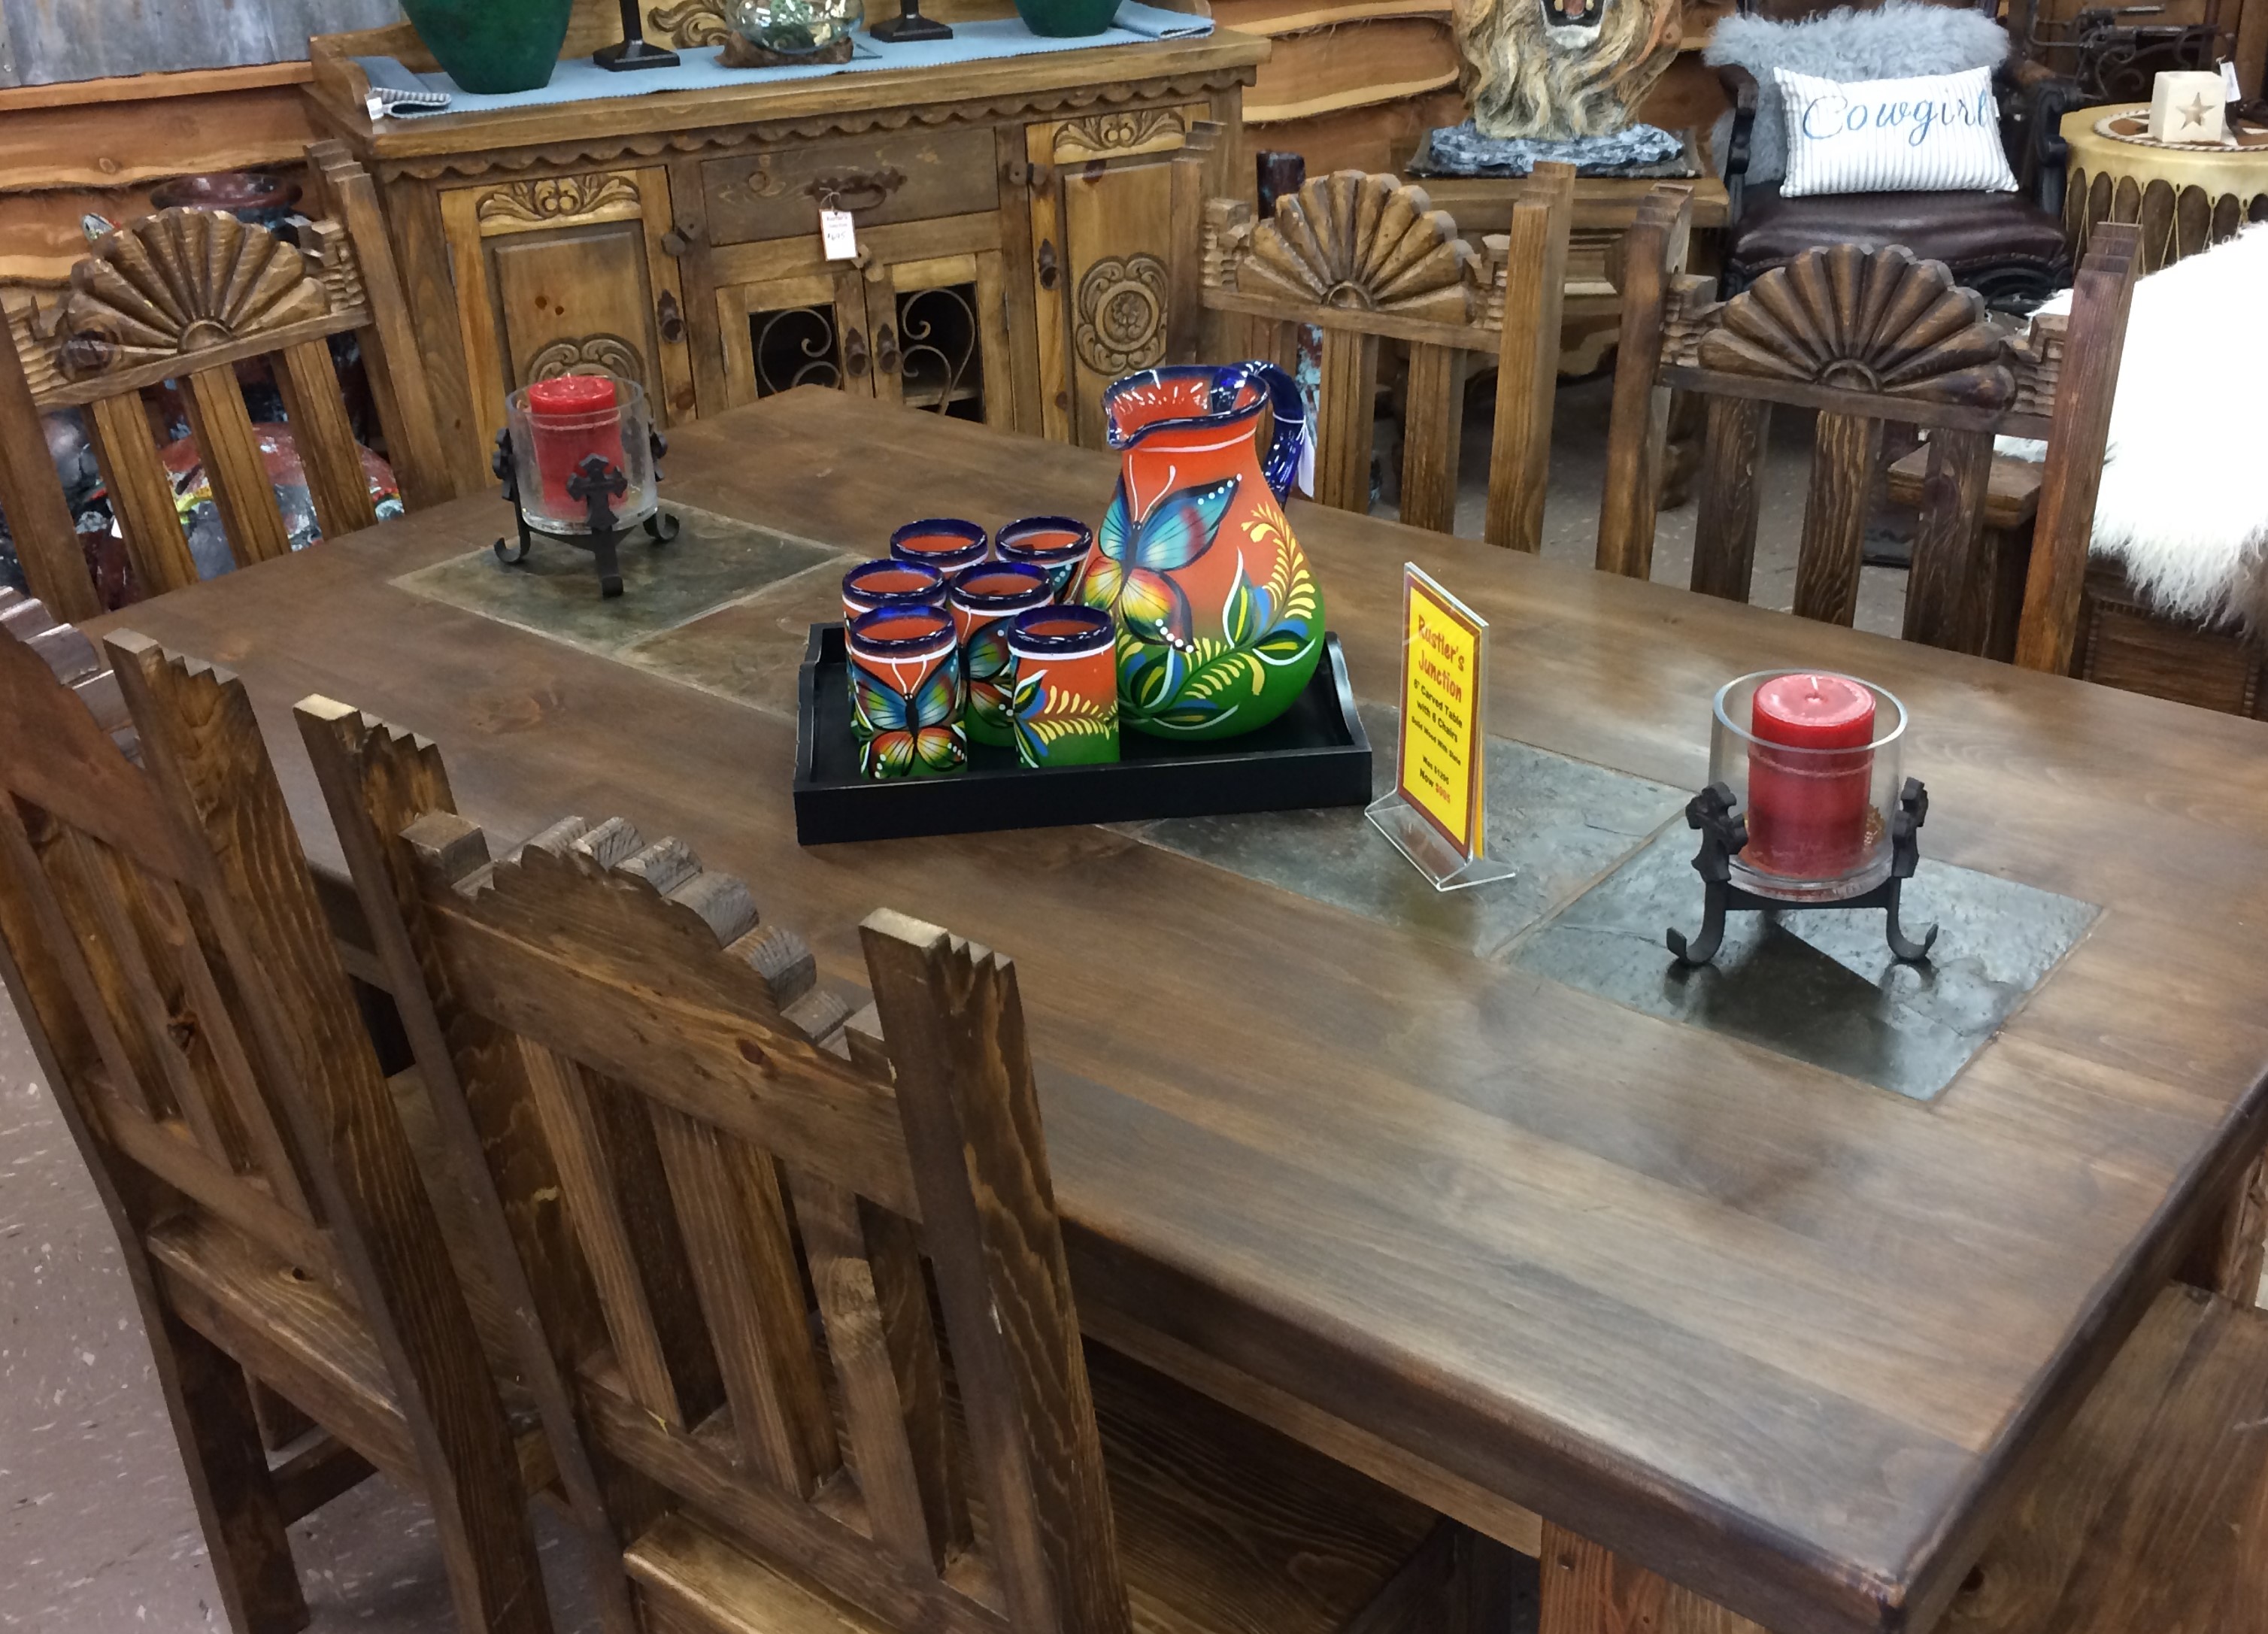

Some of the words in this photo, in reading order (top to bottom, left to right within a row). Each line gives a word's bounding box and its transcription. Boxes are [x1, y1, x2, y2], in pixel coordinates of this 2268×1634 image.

[1803, 89, 1988, 147] Cowgirl
[1418, 614, 1465, 671] Rustler's
[1418, 649, 1462, 703] Junction
[1417, 700, 1430, 718] with
[1438, 717, 1457, 743] Chairs
[1421, 685, 1443, 711] Carved
[1445, 704, 1463, 729] Table
[1424, 726, 1436, 743] Wood
[1420, 768, 1434, 787] Now
[1422, 754, 1433, 770] Was
